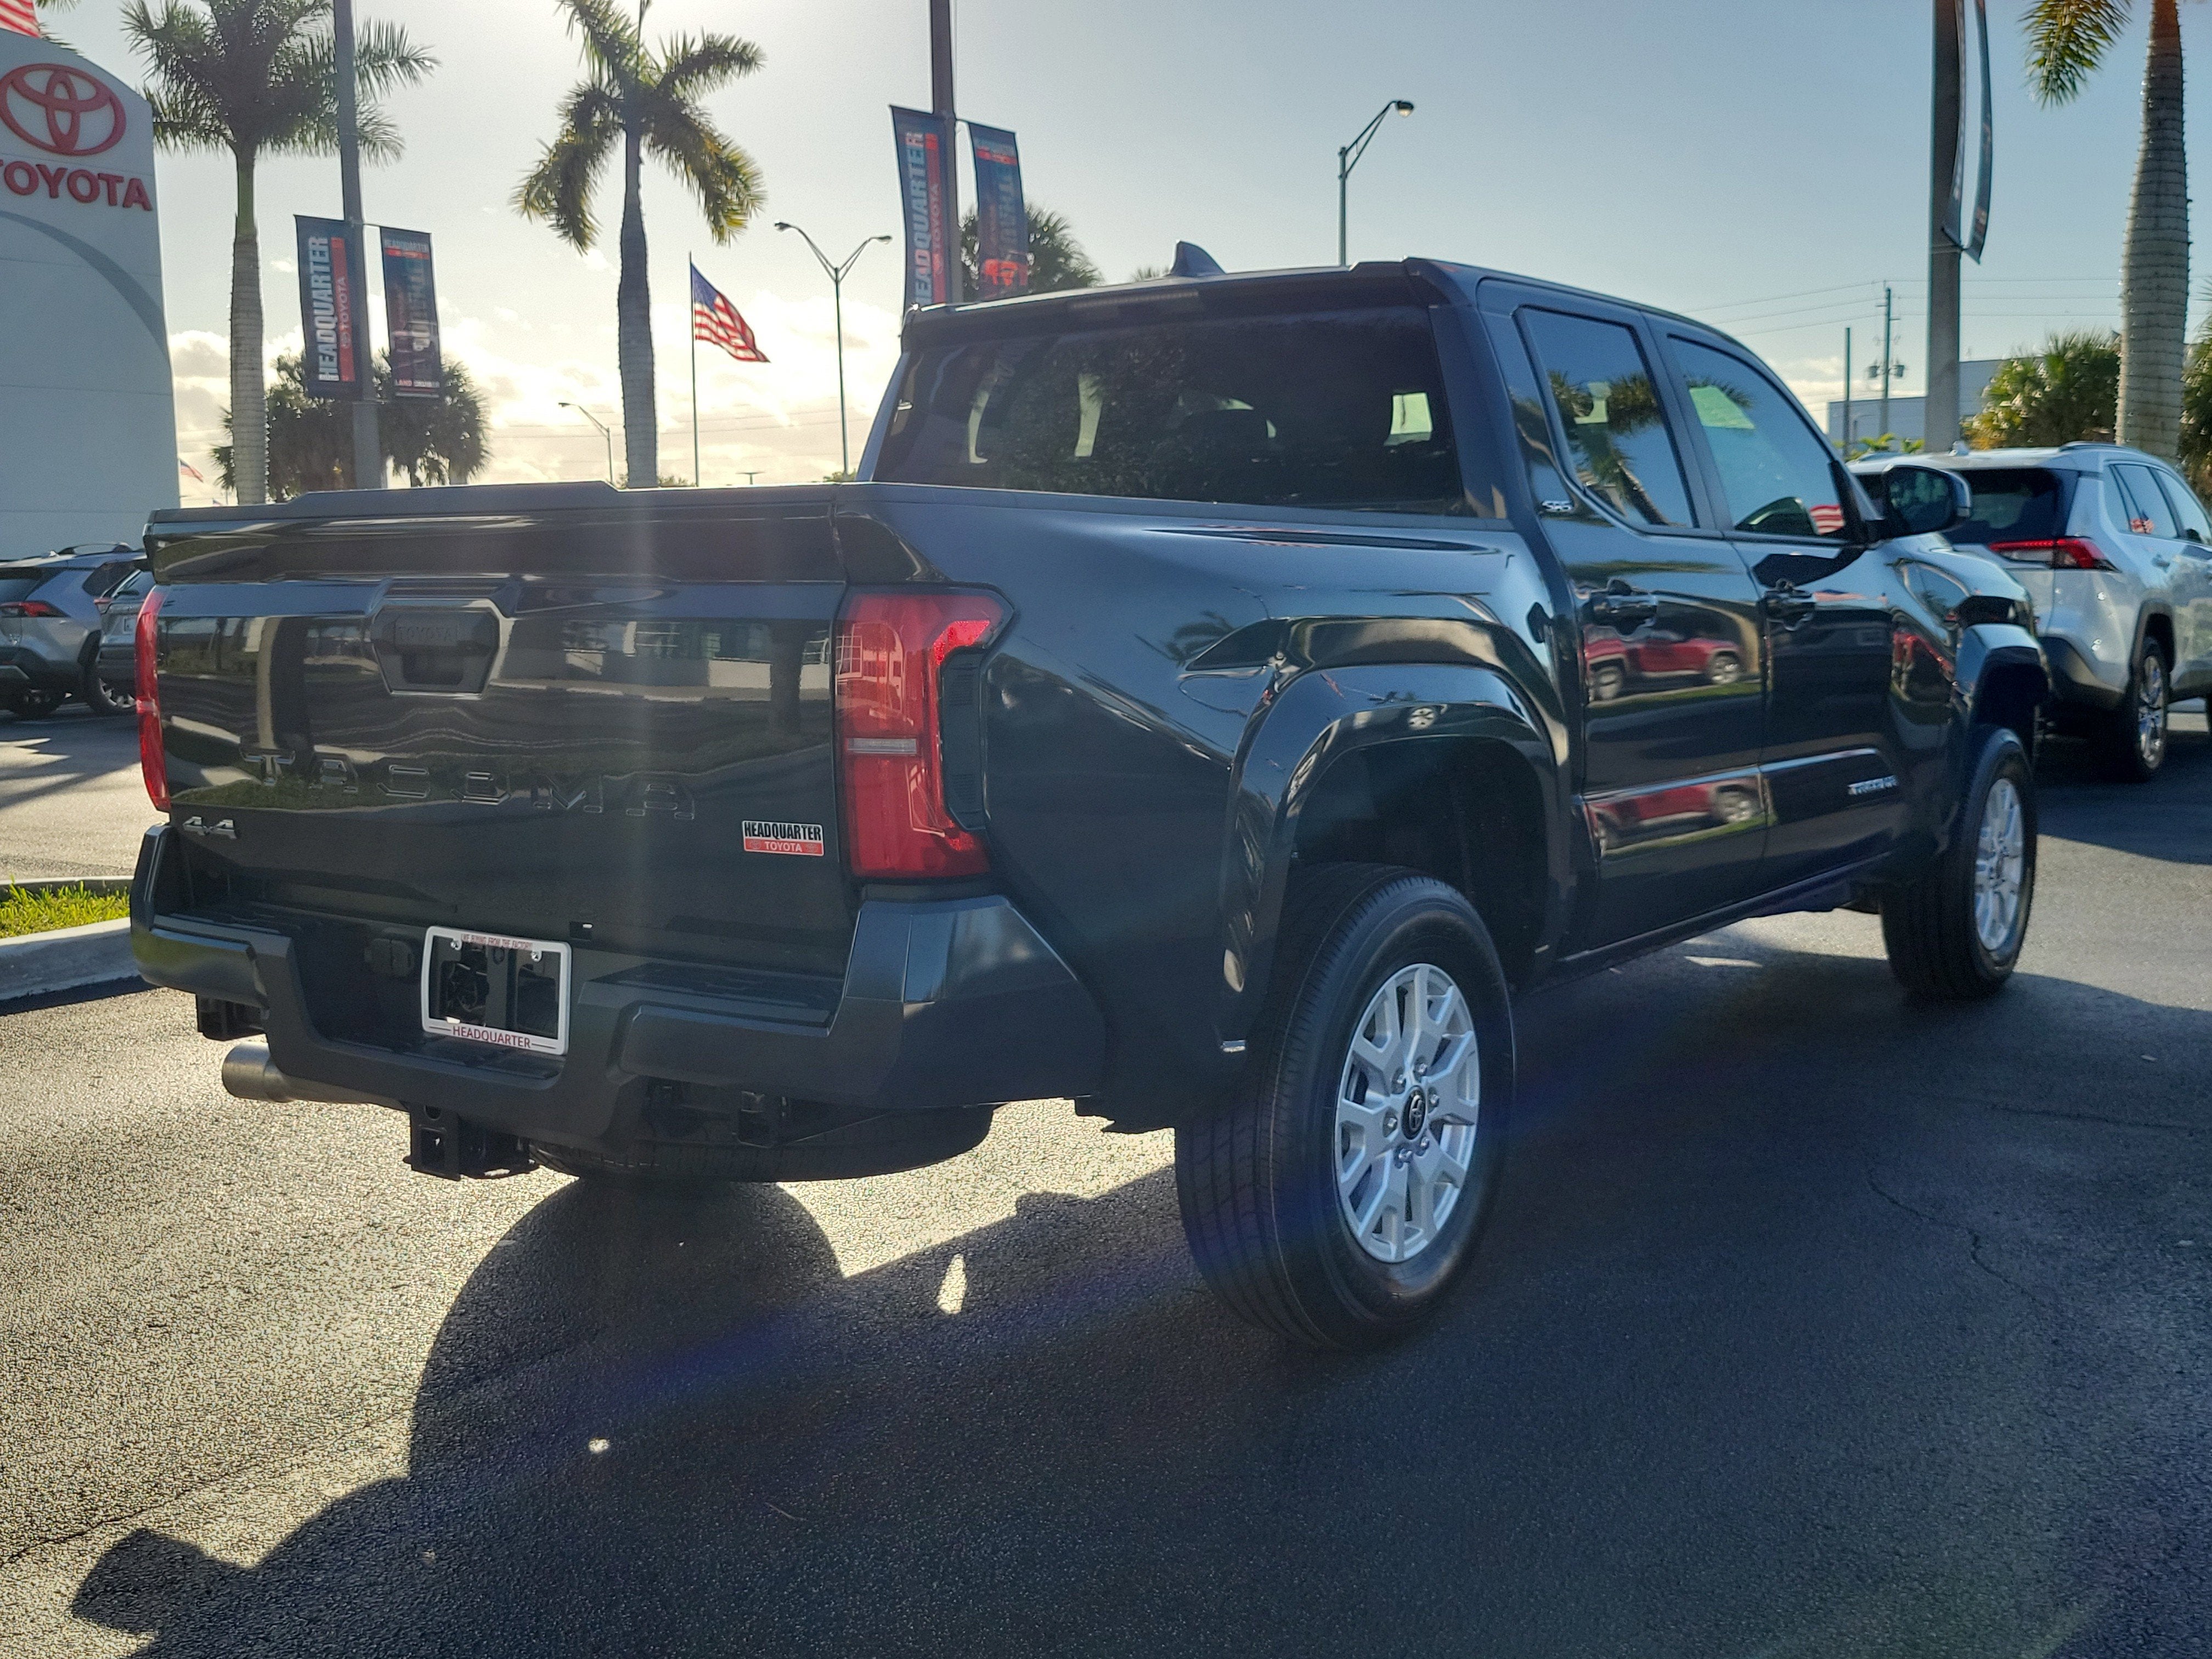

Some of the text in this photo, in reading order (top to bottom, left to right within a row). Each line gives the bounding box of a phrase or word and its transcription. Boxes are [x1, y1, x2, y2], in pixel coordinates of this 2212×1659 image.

[0, 159, 153, 211] OYOTA
[309, 236, 340, 381] HEADQUARTER
[336, 276, 351, 330] TOYOTA
[744, 821, 821, 840] HEADQUARTER
[765, 841, 803, 852] TOYOTA
[453, 1025, 531, 1048] HEADQUARTER
